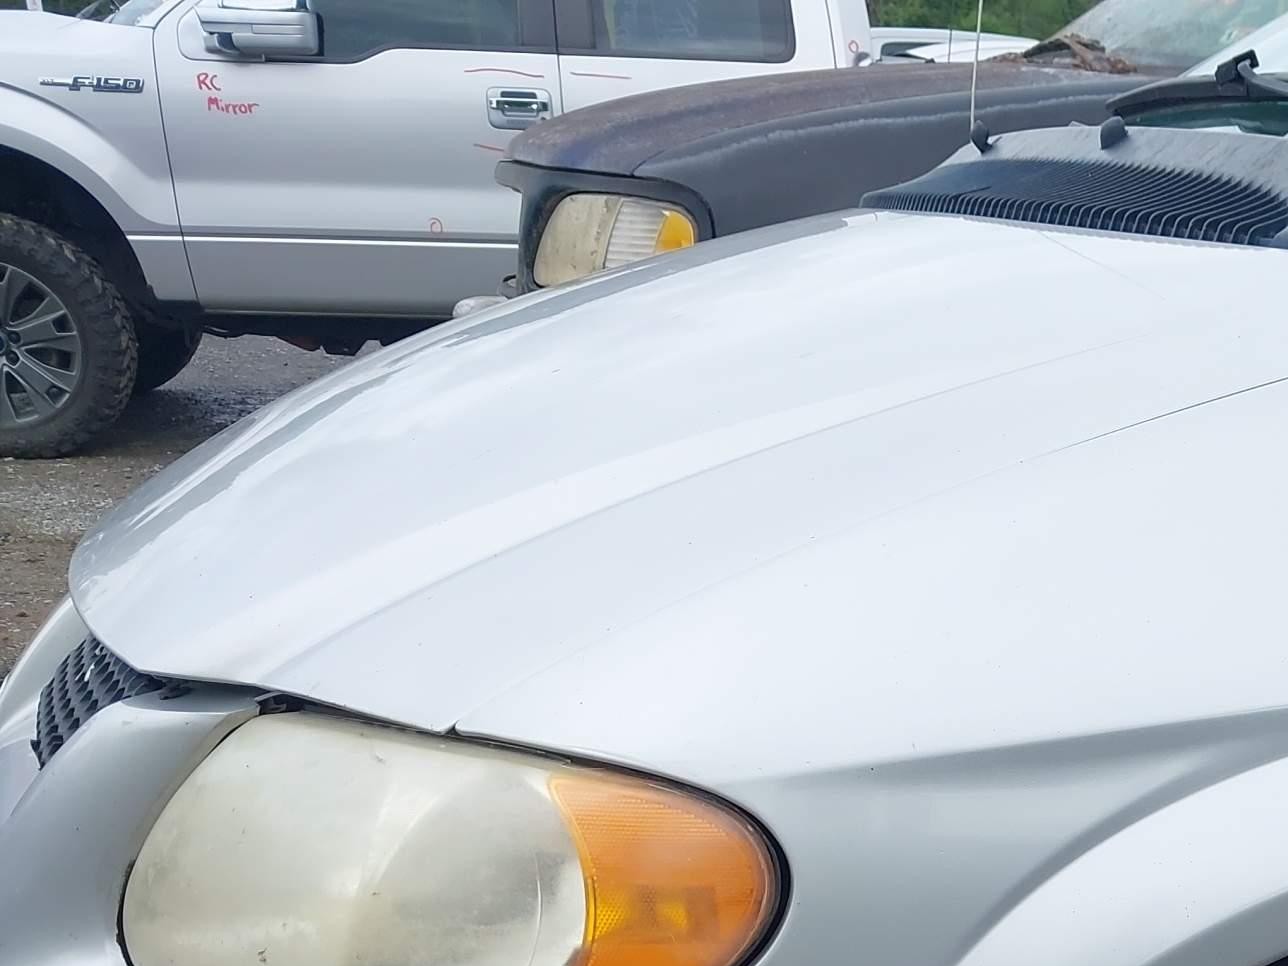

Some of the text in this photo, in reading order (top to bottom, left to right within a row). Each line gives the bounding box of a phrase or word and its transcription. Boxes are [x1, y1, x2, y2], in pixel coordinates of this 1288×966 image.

[69, 75, 145, 93] F-150
[196, 72, 222, 91] RC
[206, 96, 260, 115] Mirror
